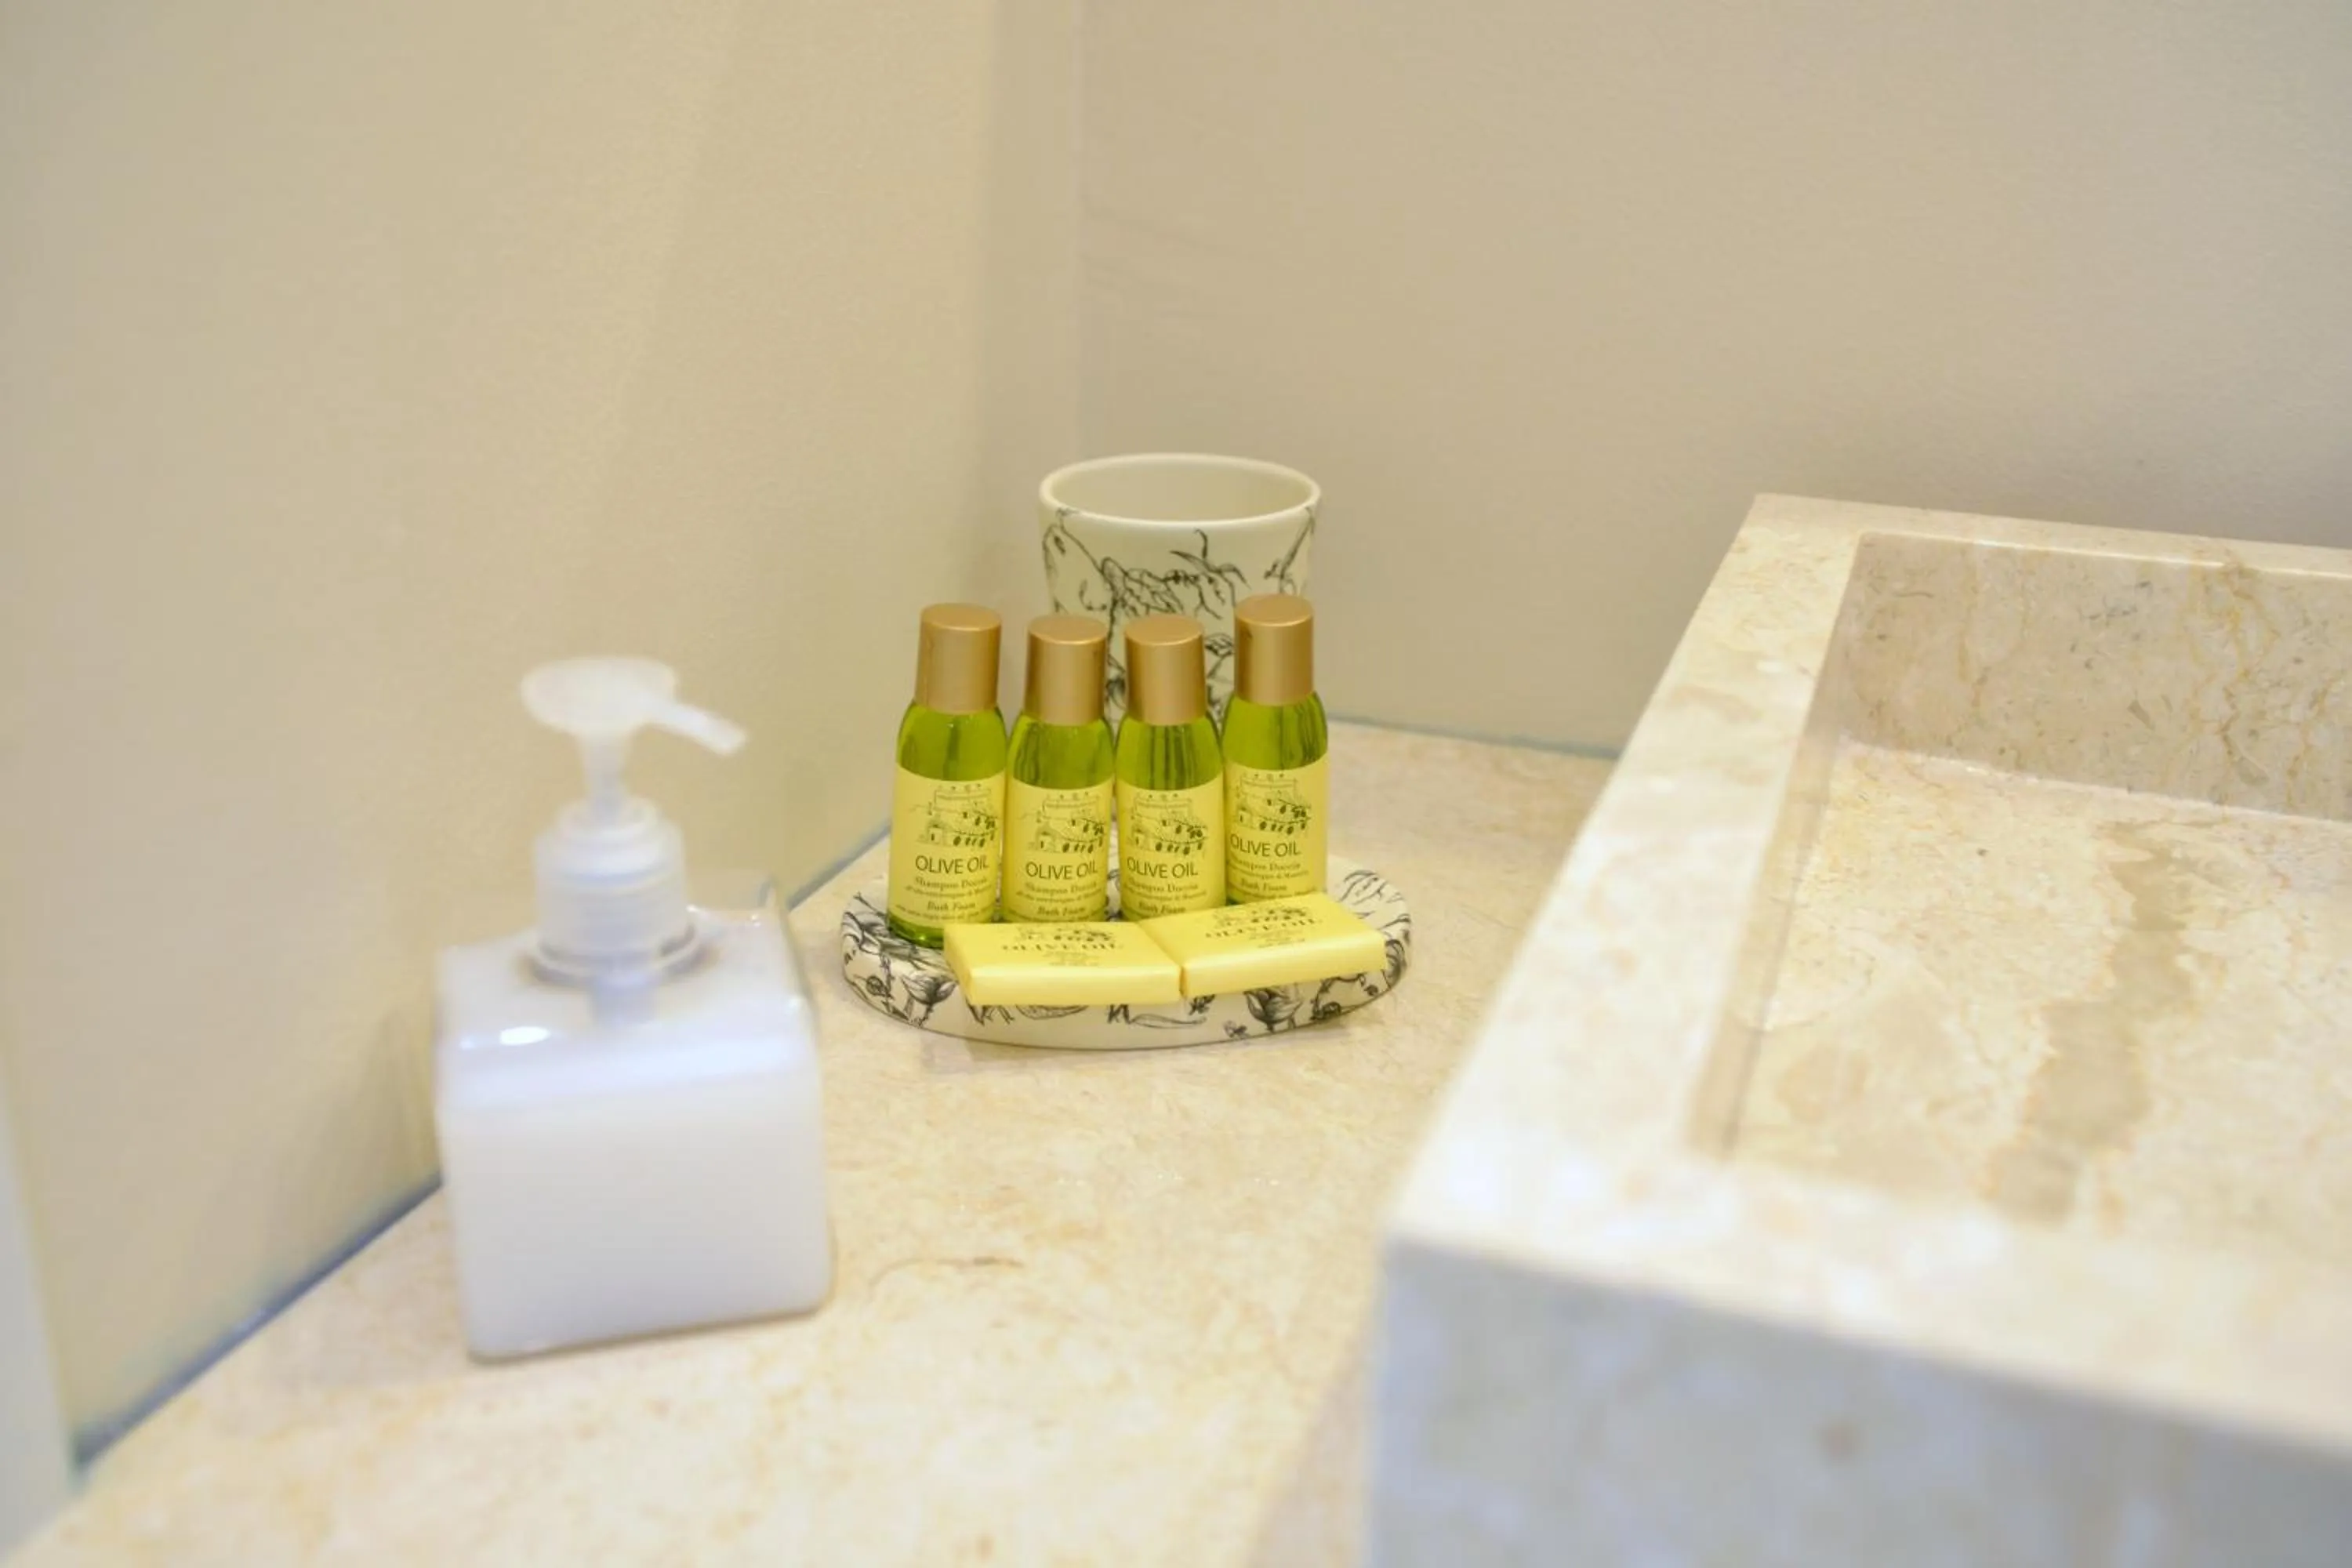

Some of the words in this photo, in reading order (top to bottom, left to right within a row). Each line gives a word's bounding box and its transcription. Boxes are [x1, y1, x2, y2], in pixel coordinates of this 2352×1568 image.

[1230, 833, 1271, 857] OLIVE
[1274, 840, 1302, 857] OIL
[915, 855, 963, 874] OLIVE
[967, 855, 989, 873] OIL
[1025, 861, 1073, 880] OLIVE
[1076, 860, 1098, 877] OIL
[1127, 856, 1168, 879] OLIVE
[1172, 862, 1199, 879] OIL
